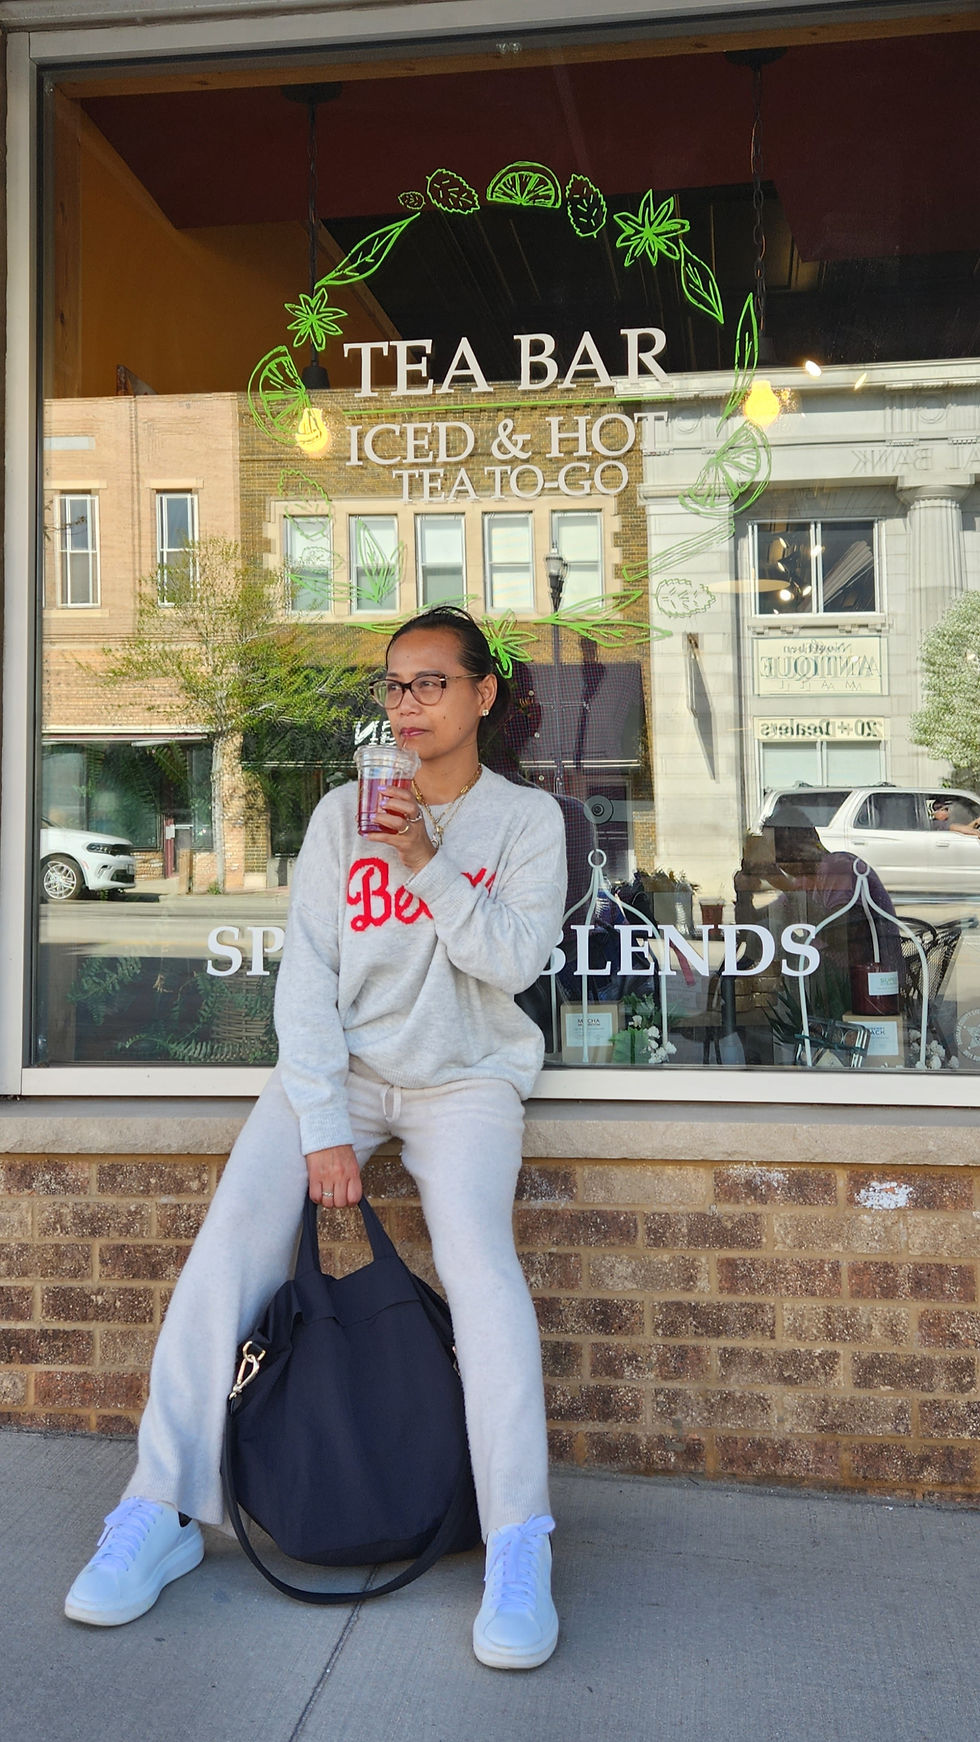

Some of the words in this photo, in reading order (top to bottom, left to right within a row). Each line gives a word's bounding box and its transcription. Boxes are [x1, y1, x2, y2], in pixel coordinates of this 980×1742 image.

[343, 336, 494, 398] TEA
[513, 326, 674, 391] BAR
[346, 421, 476, 466] ICED
[490, 417, 532, 460] &
[545, 411, 669, 458] HOT
[392, 467, 480, 502] TEA
[485, 460, 629, 499] TO-GO
